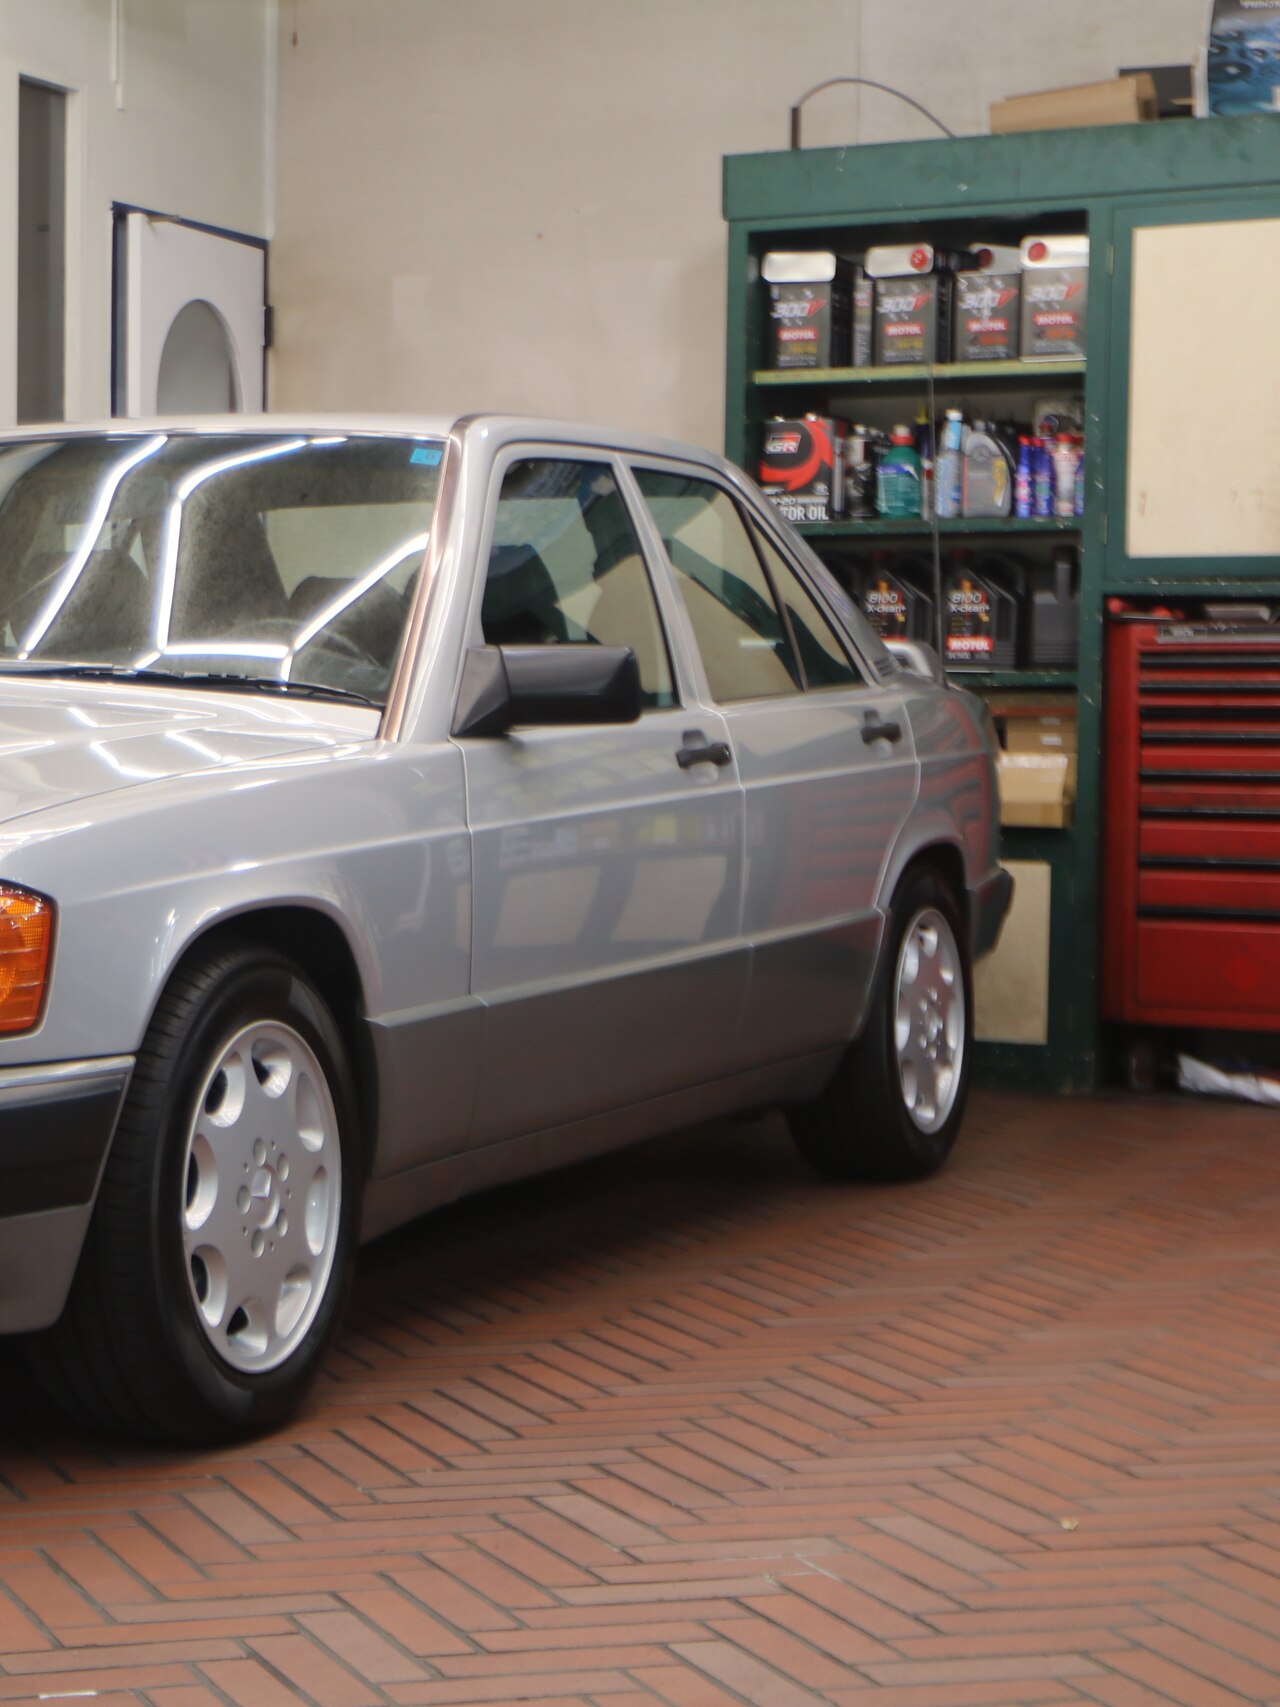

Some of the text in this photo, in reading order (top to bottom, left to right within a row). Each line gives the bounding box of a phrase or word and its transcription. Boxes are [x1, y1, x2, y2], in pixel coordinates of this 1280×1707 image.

[1037, 314, 1074, 326] MOTUL
[887, 325, 922, 337] MOTUL
[971, 322, 1007, 332] MOTUL
[780, 330, 816, 341] MOTUL
[781, 506, 829, 521] TOR OIL
[869, 593, 899, 604] 8100
[951, 593, 982, 604] 8100
[951, 640, 990, 651] MOTUL
